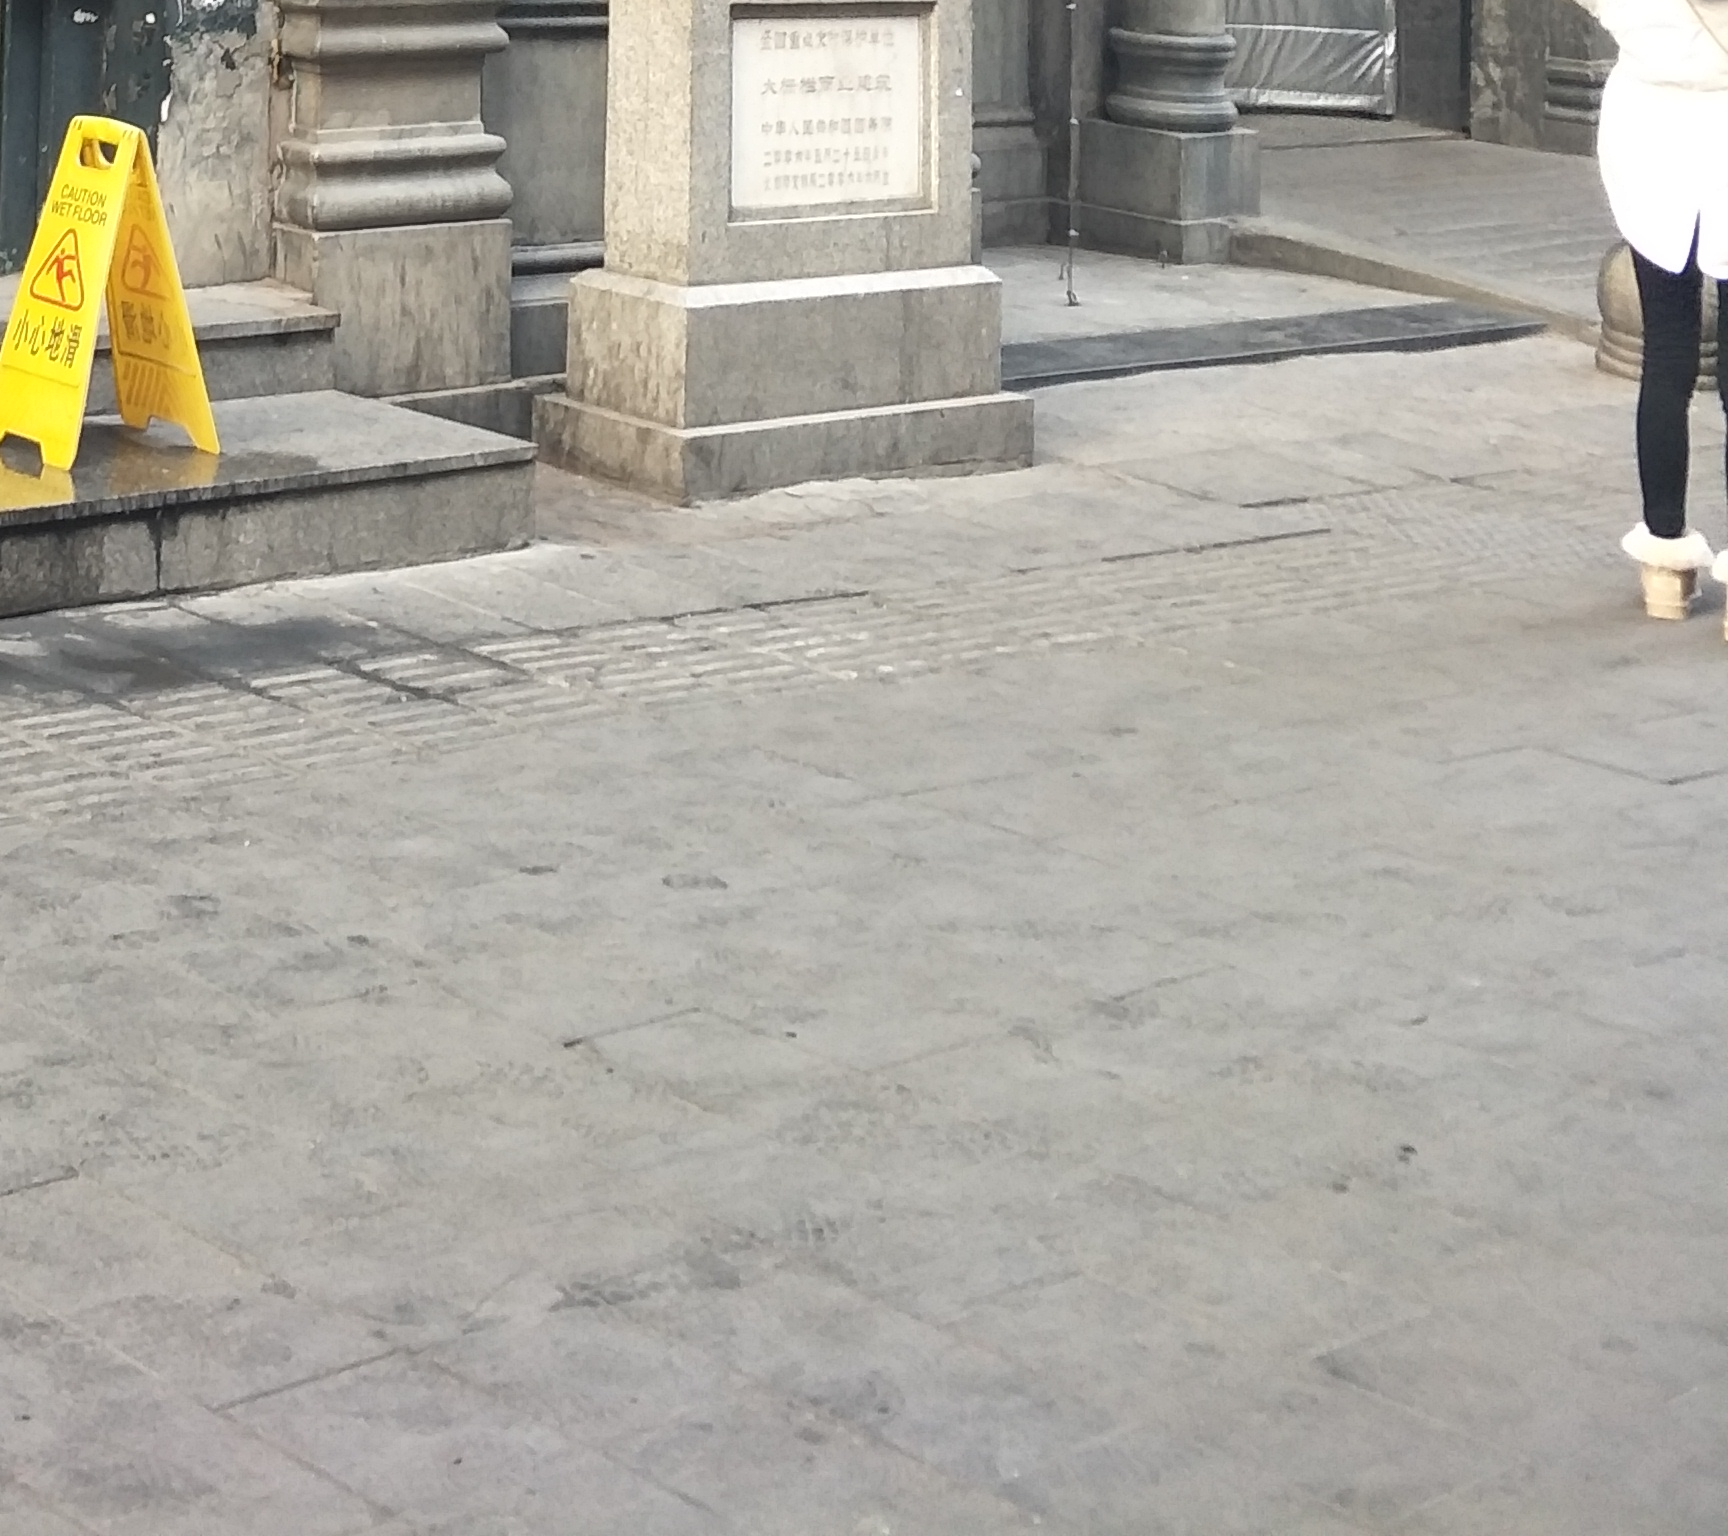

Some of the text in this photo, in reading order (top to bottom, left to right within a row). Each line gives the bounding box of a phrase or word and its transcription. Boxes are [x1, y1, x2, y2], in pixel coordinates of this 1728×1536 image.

[60, 183, 108, 209] CAUTION
[51, 200, 108, 227] WET FLOOR
[12, 308, 83, 369] 小心地滑
